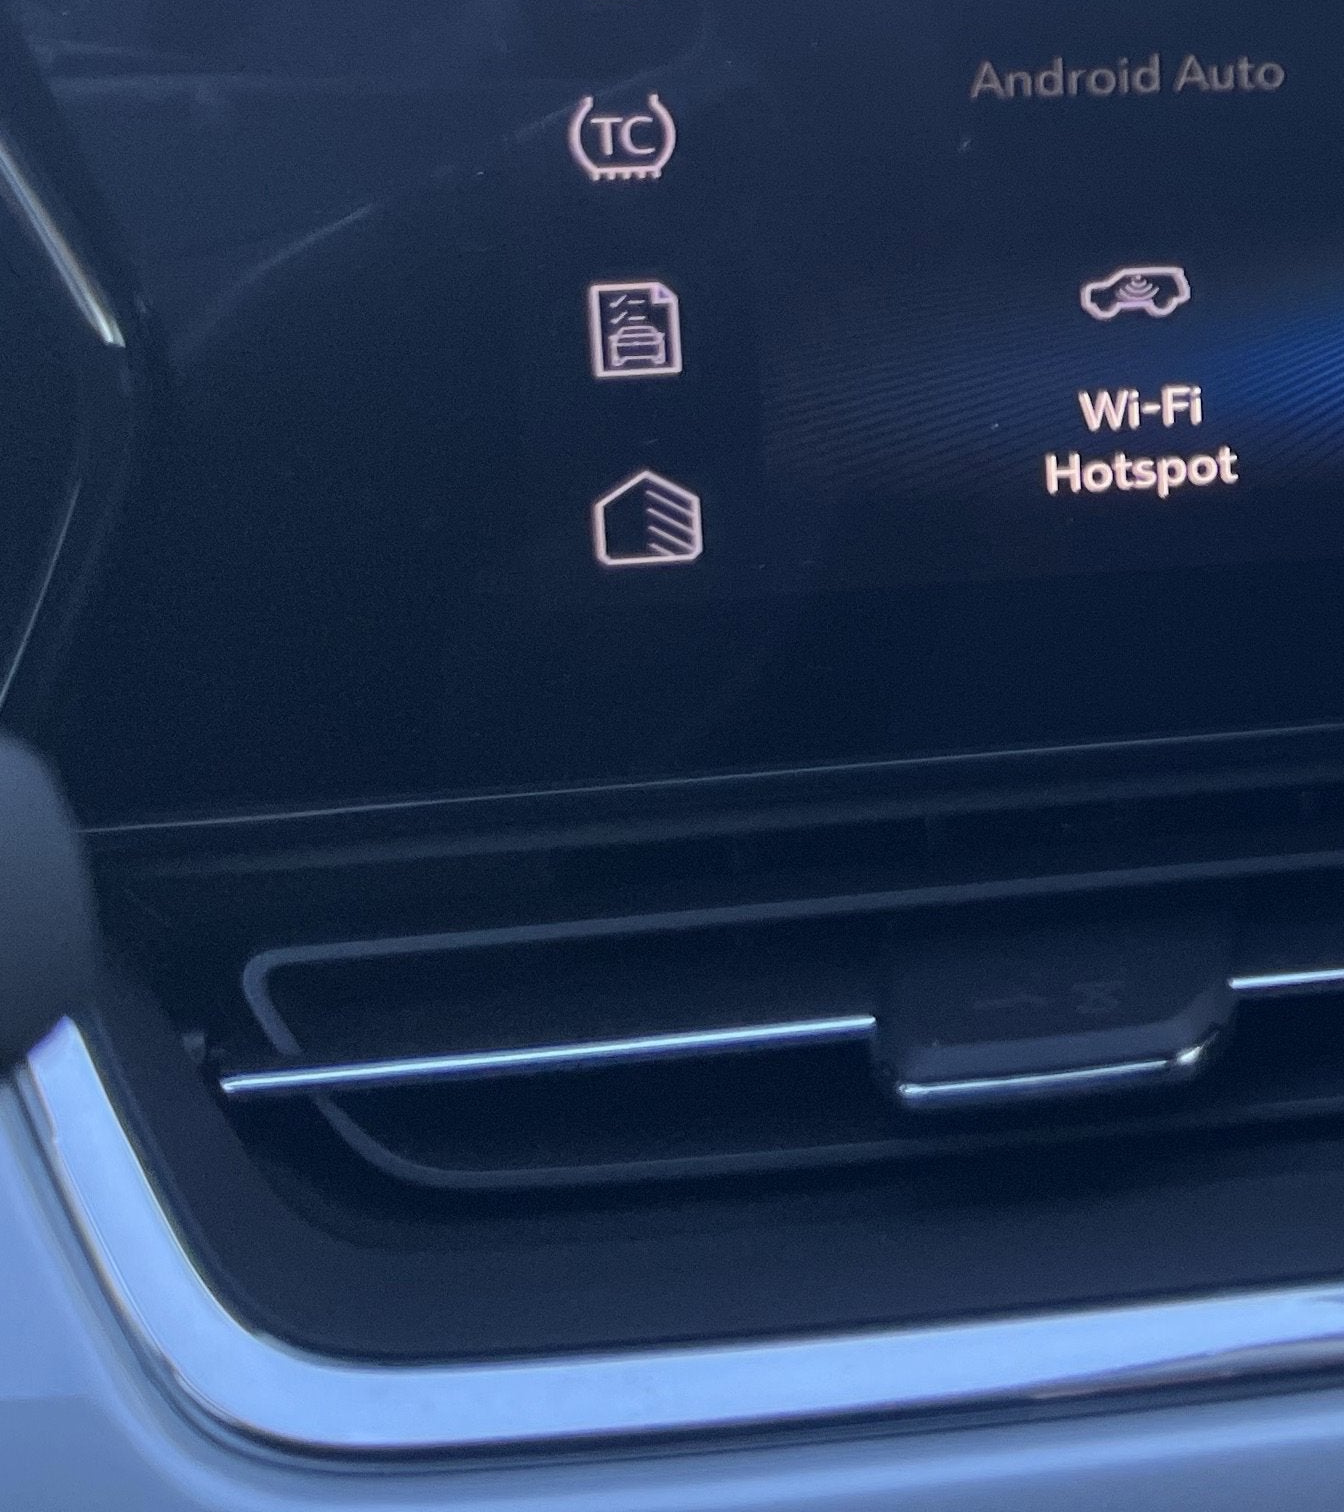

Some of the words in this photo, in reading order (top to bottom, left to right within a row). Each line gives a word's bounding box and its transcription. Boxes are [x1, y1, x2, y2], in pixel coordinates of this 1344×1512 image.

[969, 52, 1161, 100] Android
[1175, 53, 1286, 94] Auto
[590, 114, 656, 156] TC
[1077, 384, 1203, 433] Wi-Fi
[1044, 445, 1240, 499] Hotspot
